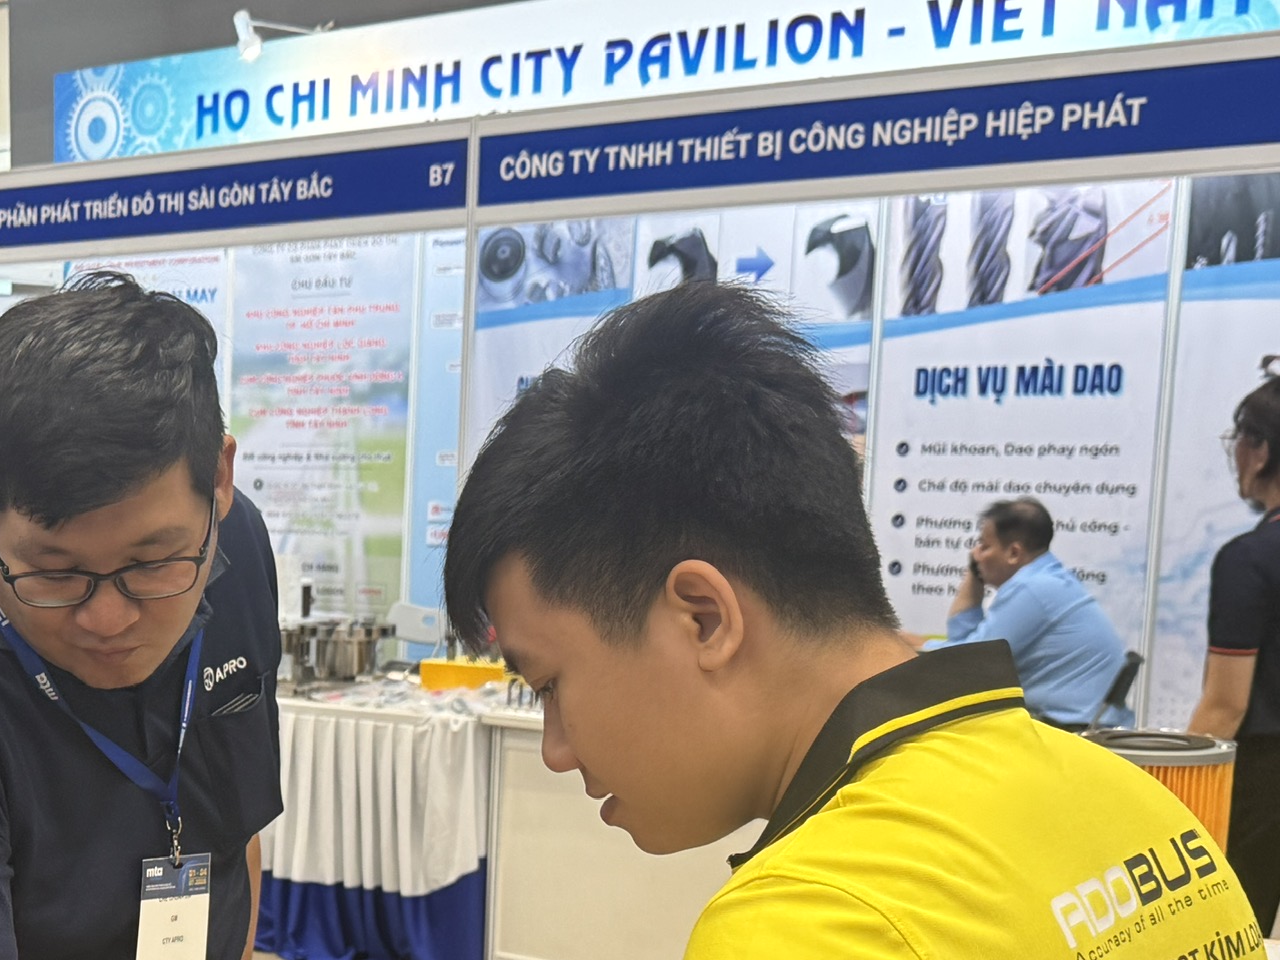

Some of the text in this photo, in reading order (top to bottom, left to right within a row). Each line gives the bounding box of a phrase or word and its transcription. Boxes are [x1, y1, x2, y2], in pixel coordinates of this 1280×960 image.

[196, 88, 250, 139] HO
[265, 78, 331, 130] CHI
[350, 60, 461, 113] MINH
[481, 44, 584, 97] CITY
[603, 8, 866, 88] PAVILION
[500, 92, 1148, 181] CÔNG TY TNHH THIẾT BỊ CÔNG NGHIỆP HIỆP PHÁT
[40, 198, 79, 224] PHÁT
[132, 190, 154, 216] ĐÔ
[157, 191, 184, 216] THỊ
[188, 185, 215, 211] SÀI
[219, 180, 255, 207] GÒN
[258, 176, 293, 203] TÂY
[429, 163, 455, 187] B7
[186, 288, 217, 303] MAY
[915, 357, 1124, 405] DỊCH VỤ MÀI DAO
[216, 656, 247, 682] APRO
[1050, 828, 1218, 950] ADOBUS
[1134, 915, 1146, 934] of
[1149, 908, 1165, 925] all
[1168, 895, 1193, 916] the
[1198, 879, 1229, 900] time
